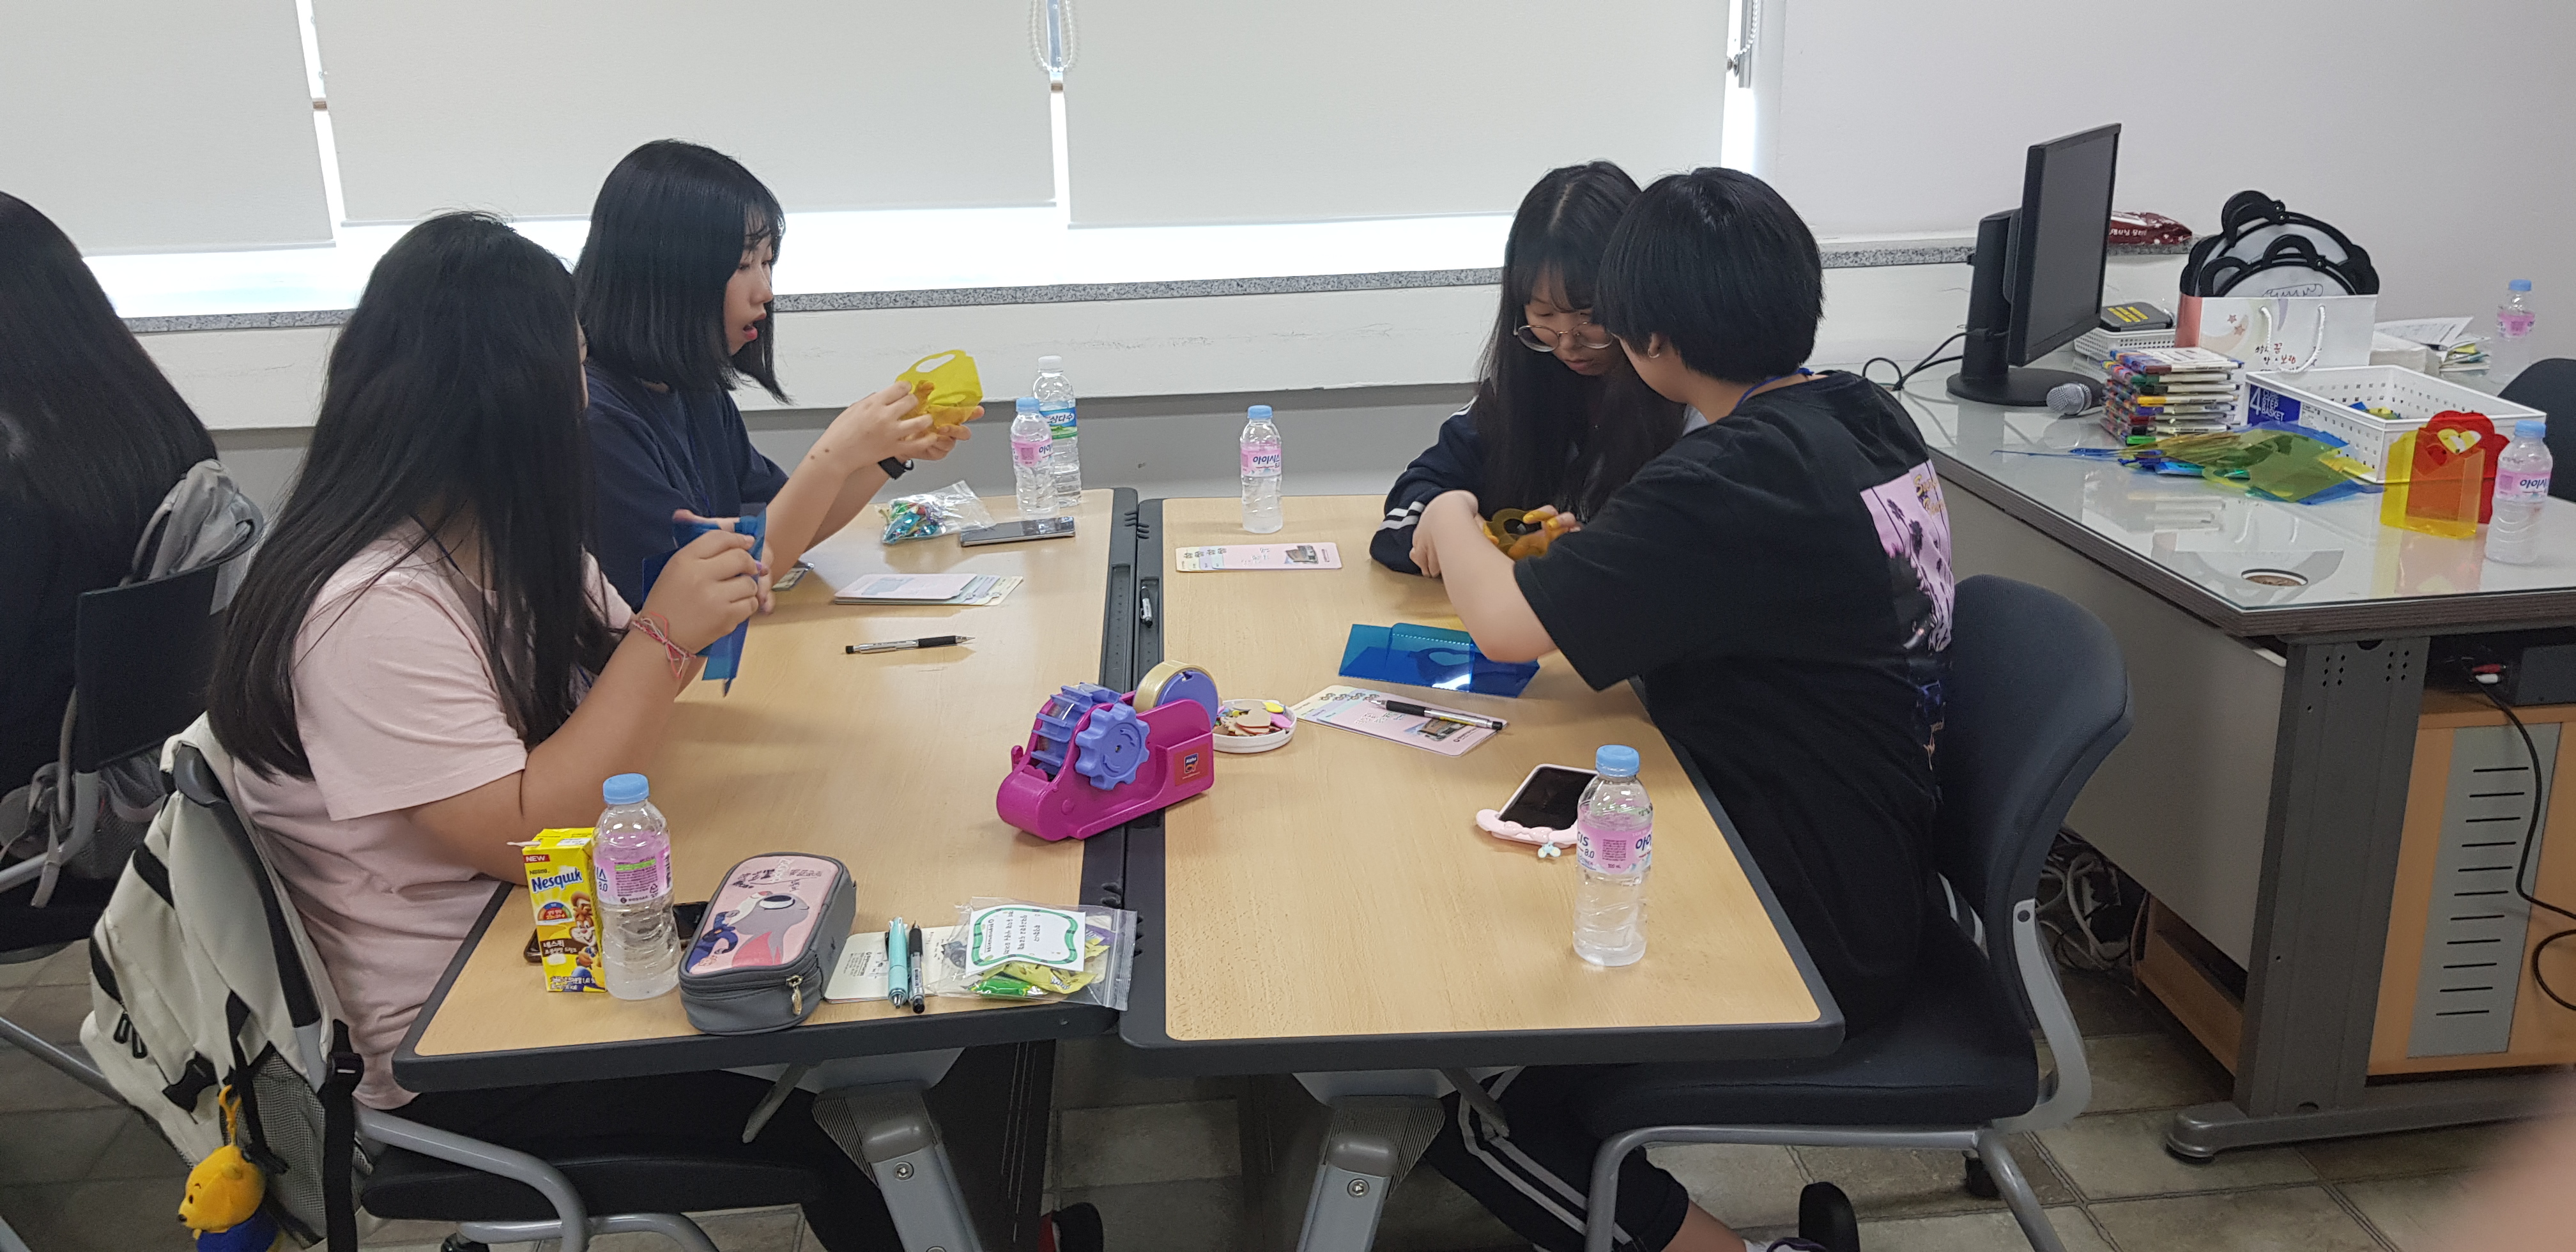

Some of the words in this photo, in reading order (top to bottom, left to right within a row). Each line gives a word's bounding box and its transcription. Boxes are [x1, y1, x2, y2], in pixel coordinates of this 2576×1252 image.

[2250, 387, 2262, 415] 4
[2262, 397, 2279, 409] STEP
[2262, 406, 2285, 422] BASKET
[1584, 848, 1595, 859] 8.0
[531, 867, 583, 892] Nesquik
